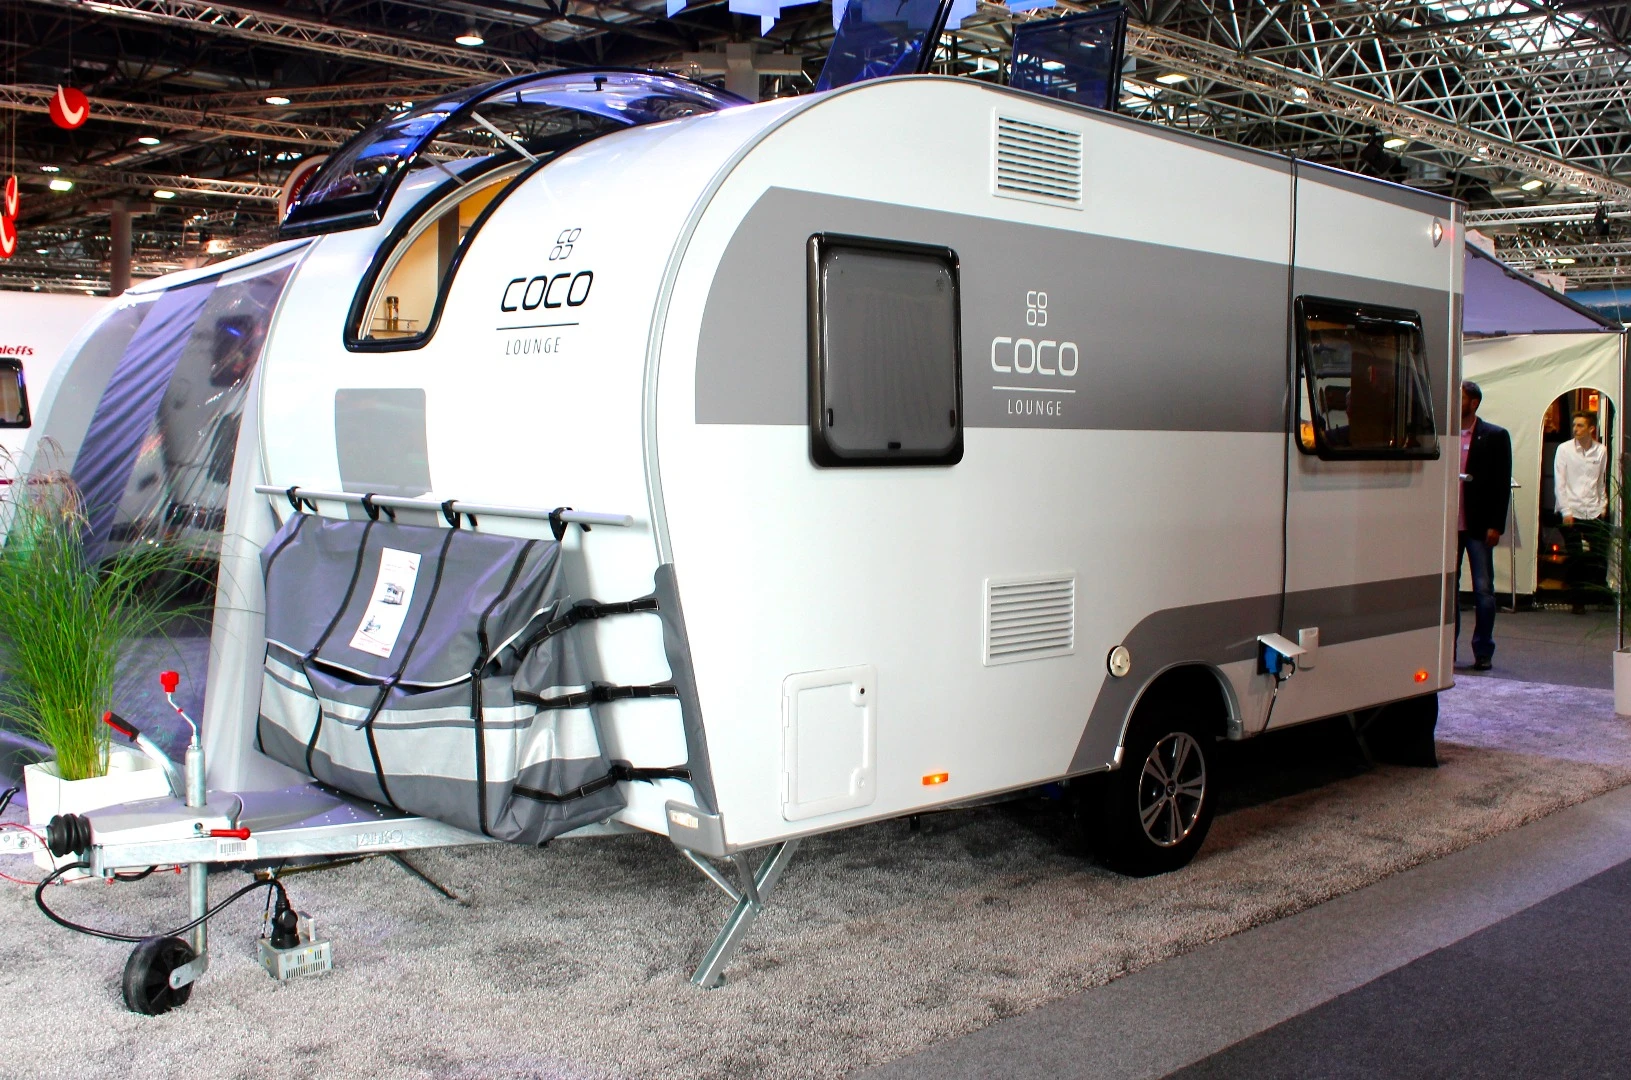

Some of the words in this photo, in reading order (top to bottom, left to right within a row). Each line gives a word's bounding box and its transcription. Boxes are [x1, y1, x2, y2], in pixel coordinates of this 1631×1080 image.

[500, 270, 594, 312] COCO
[505, 337, 561, 355] LOUNGE
[991, 336, 1079, 377] COCO
[1007, 398, 1062, 416] LOUNGE
